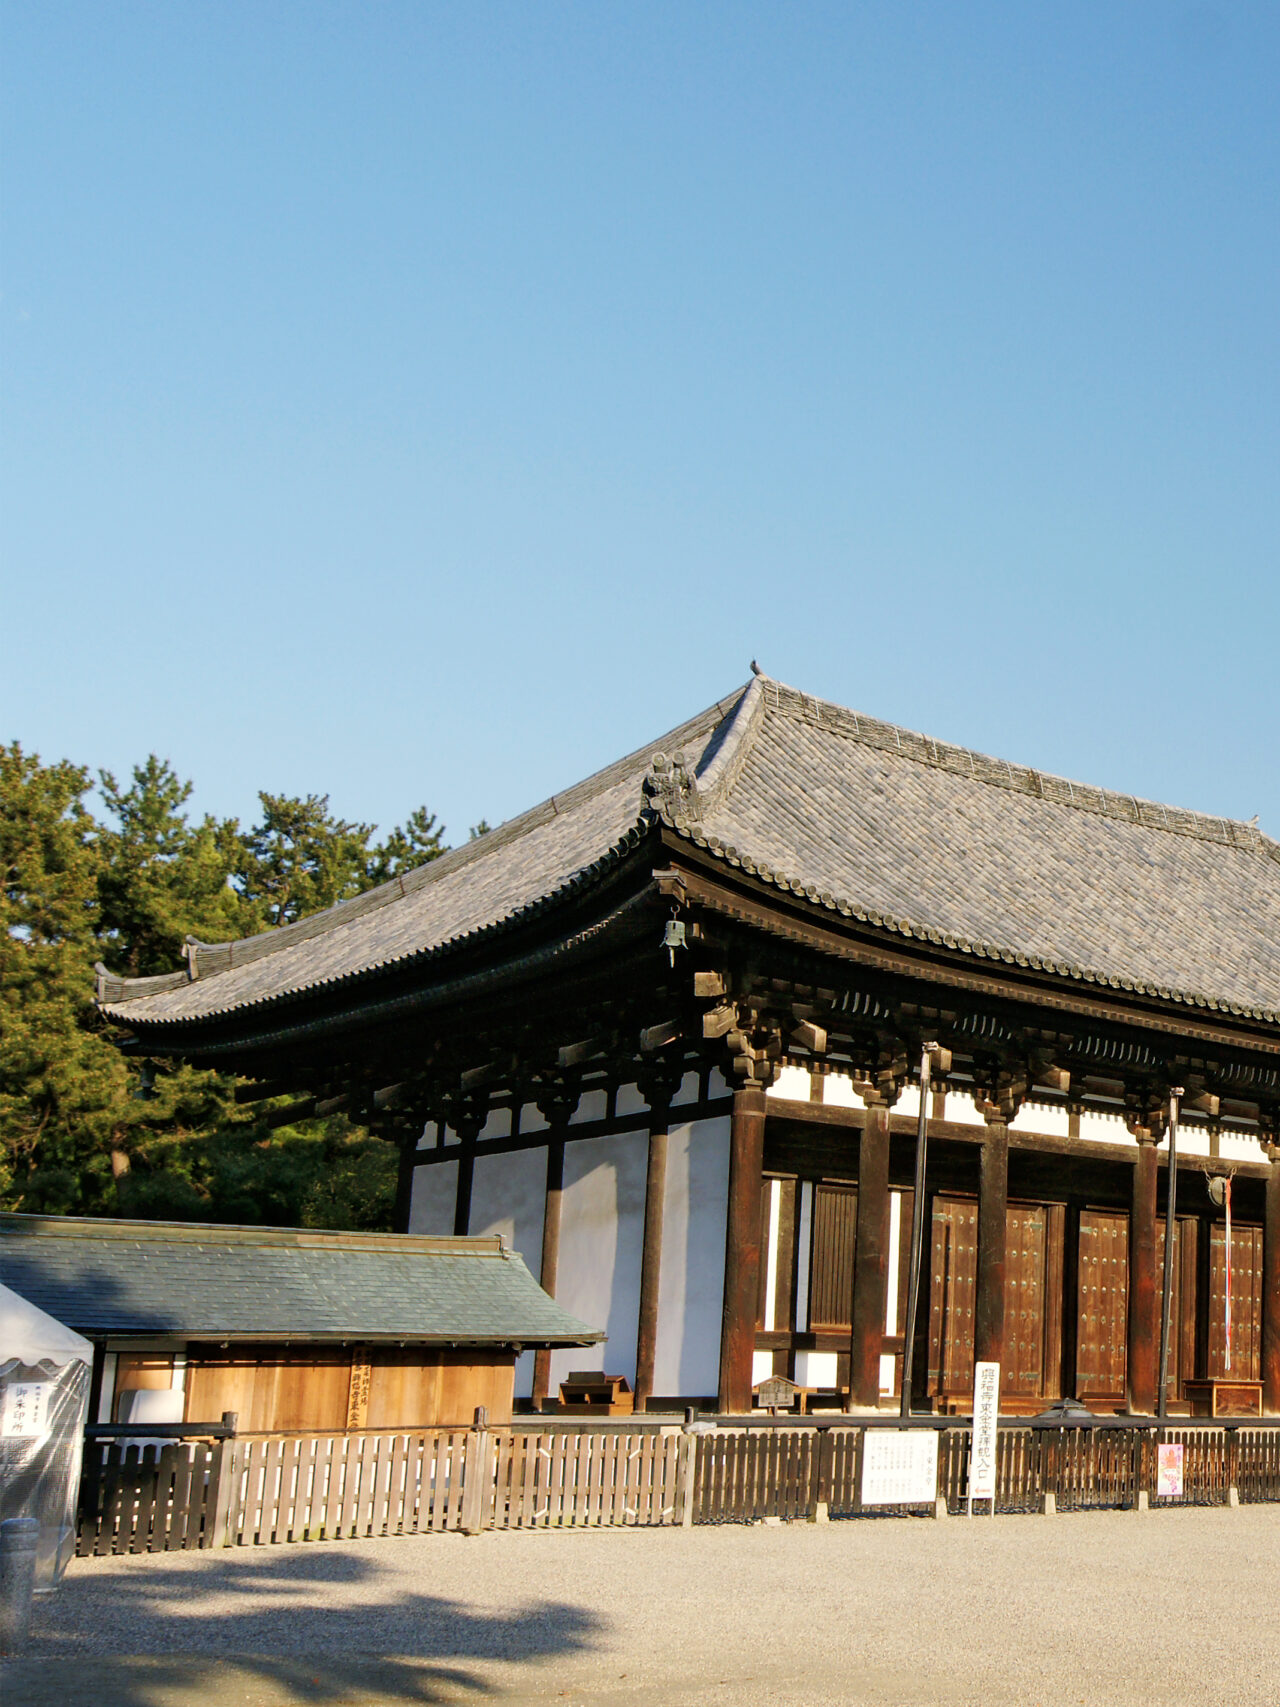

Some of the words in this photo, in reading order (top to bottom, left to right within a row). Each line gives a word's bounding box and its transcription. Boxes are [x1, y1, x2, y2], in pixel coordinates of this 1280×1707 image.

[11, 1384, 28, 1433] 御朱印所
[977, 1368, 995, 1479] 興福寺東金堂拝観入口
